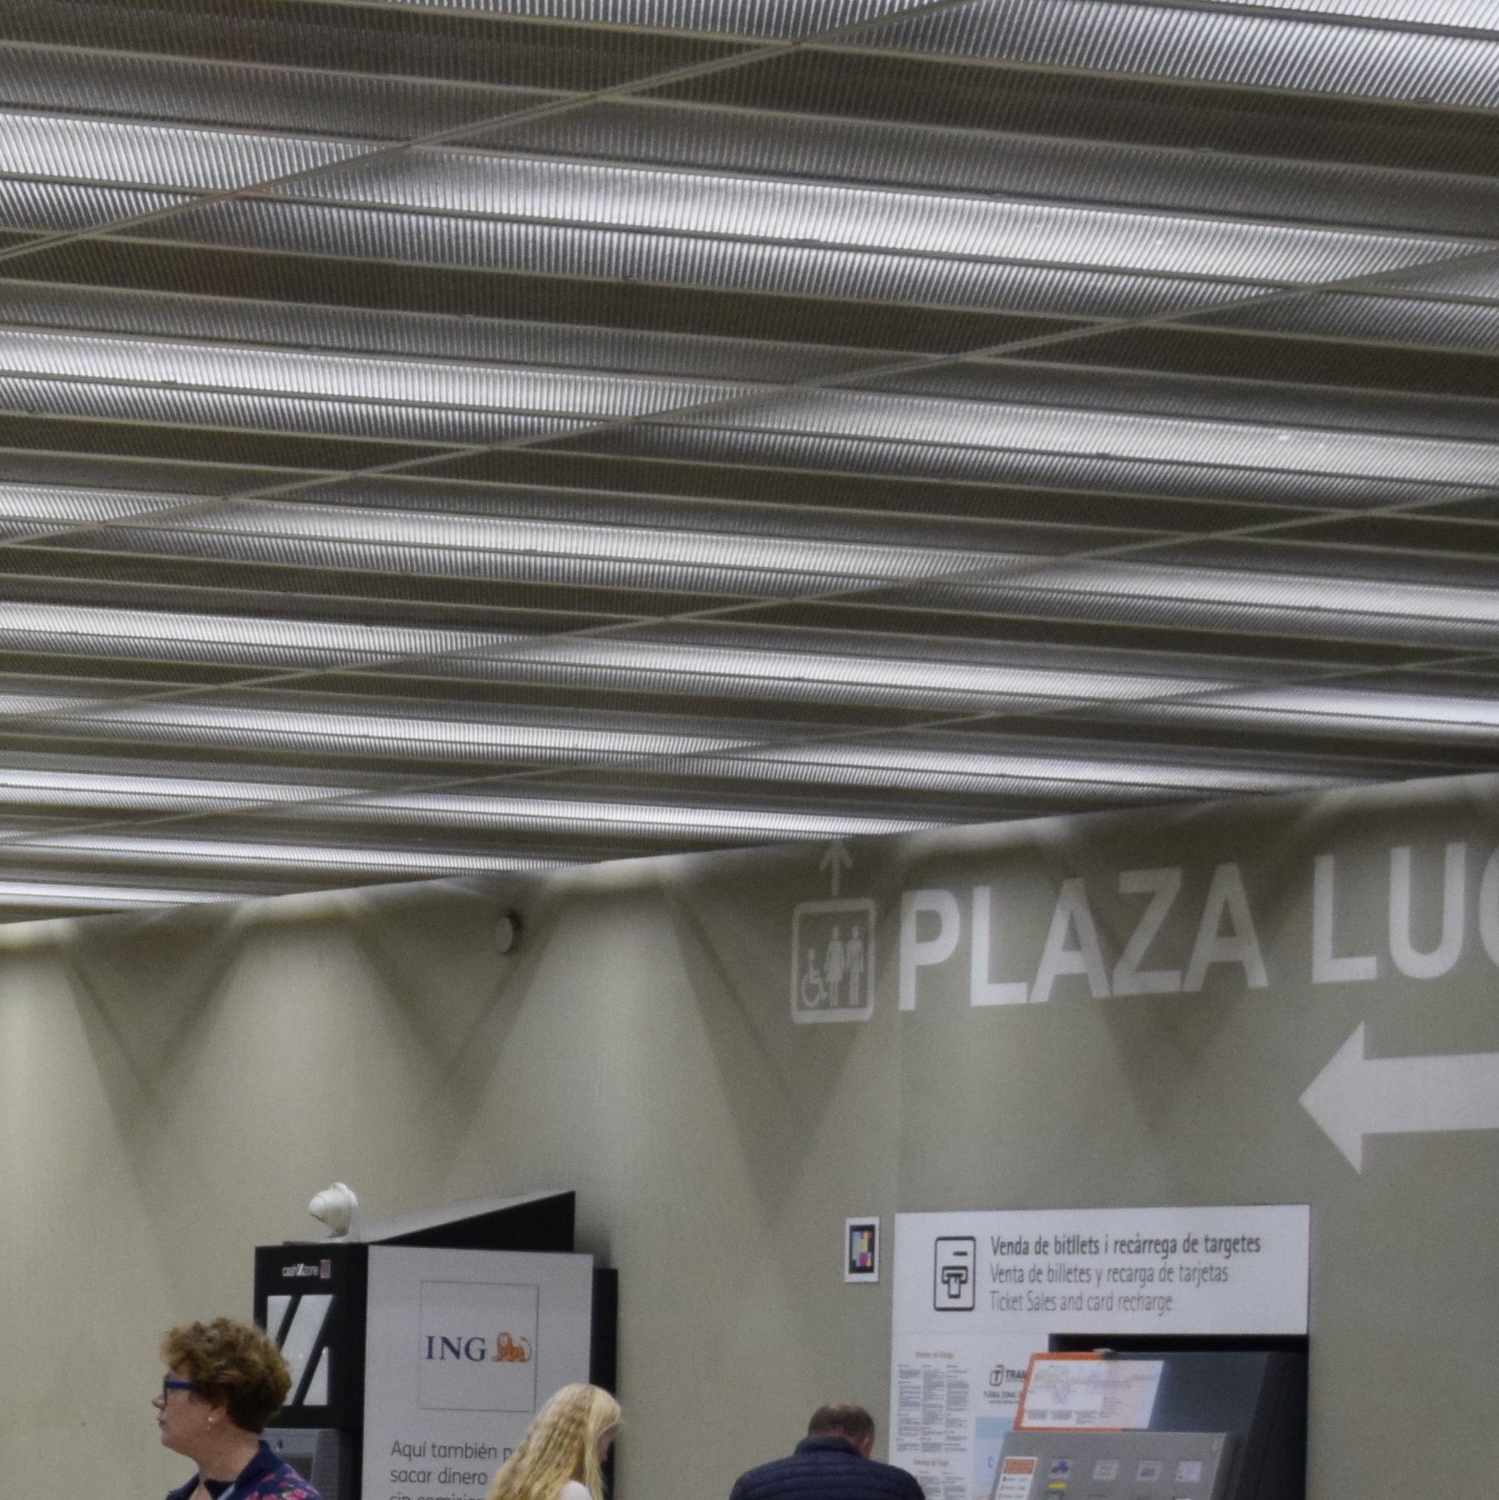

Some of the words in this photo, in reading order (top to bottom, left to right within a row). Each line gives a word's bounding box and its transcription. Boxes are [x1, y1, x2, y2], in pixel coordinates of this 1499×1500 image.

[899, 862, 1269, 1011] PLAZA
[990, 1236, 1029, 1255] Venda
[1034, 1235, 1049, 1255] de
[1054, 1234, 1100, 1255] bitllets
[1114, 1233, 1177, 1259] recàrrega
[1182, 1233, 1198, 1253] de
[1204, 1233, 1261, 1258] targetes
[990, 1264, 1024, 1284] Venta
[1029, 1263, 1043, 1283] de
[1047, 1263, 1091, 1283] billetes
[1096, 1268, 1102, 1287] y
[1107, 1265, 1154, 1288] recarga
[1159, 1262, 1174, 1283] de
[1179, 1260, 1229, 1287] tarjetas
[990, 1290, 1024, 1312] Ticket
[1027, 1290, 1057, 1312] Sales
[1061, 1290, 1082, 1312] and
[1087, 1290, 1113, 1311] card
[1118, 1290, 1173, 1316] recharge
[426, 1336, 486, 1361] ING
[391, 1441, 427, 1461] Aquí
[432, 1442, 498, 1460] también
[390, 1469, 432, 1484] sacar
[438, 1467, 488, 1486] dinero
